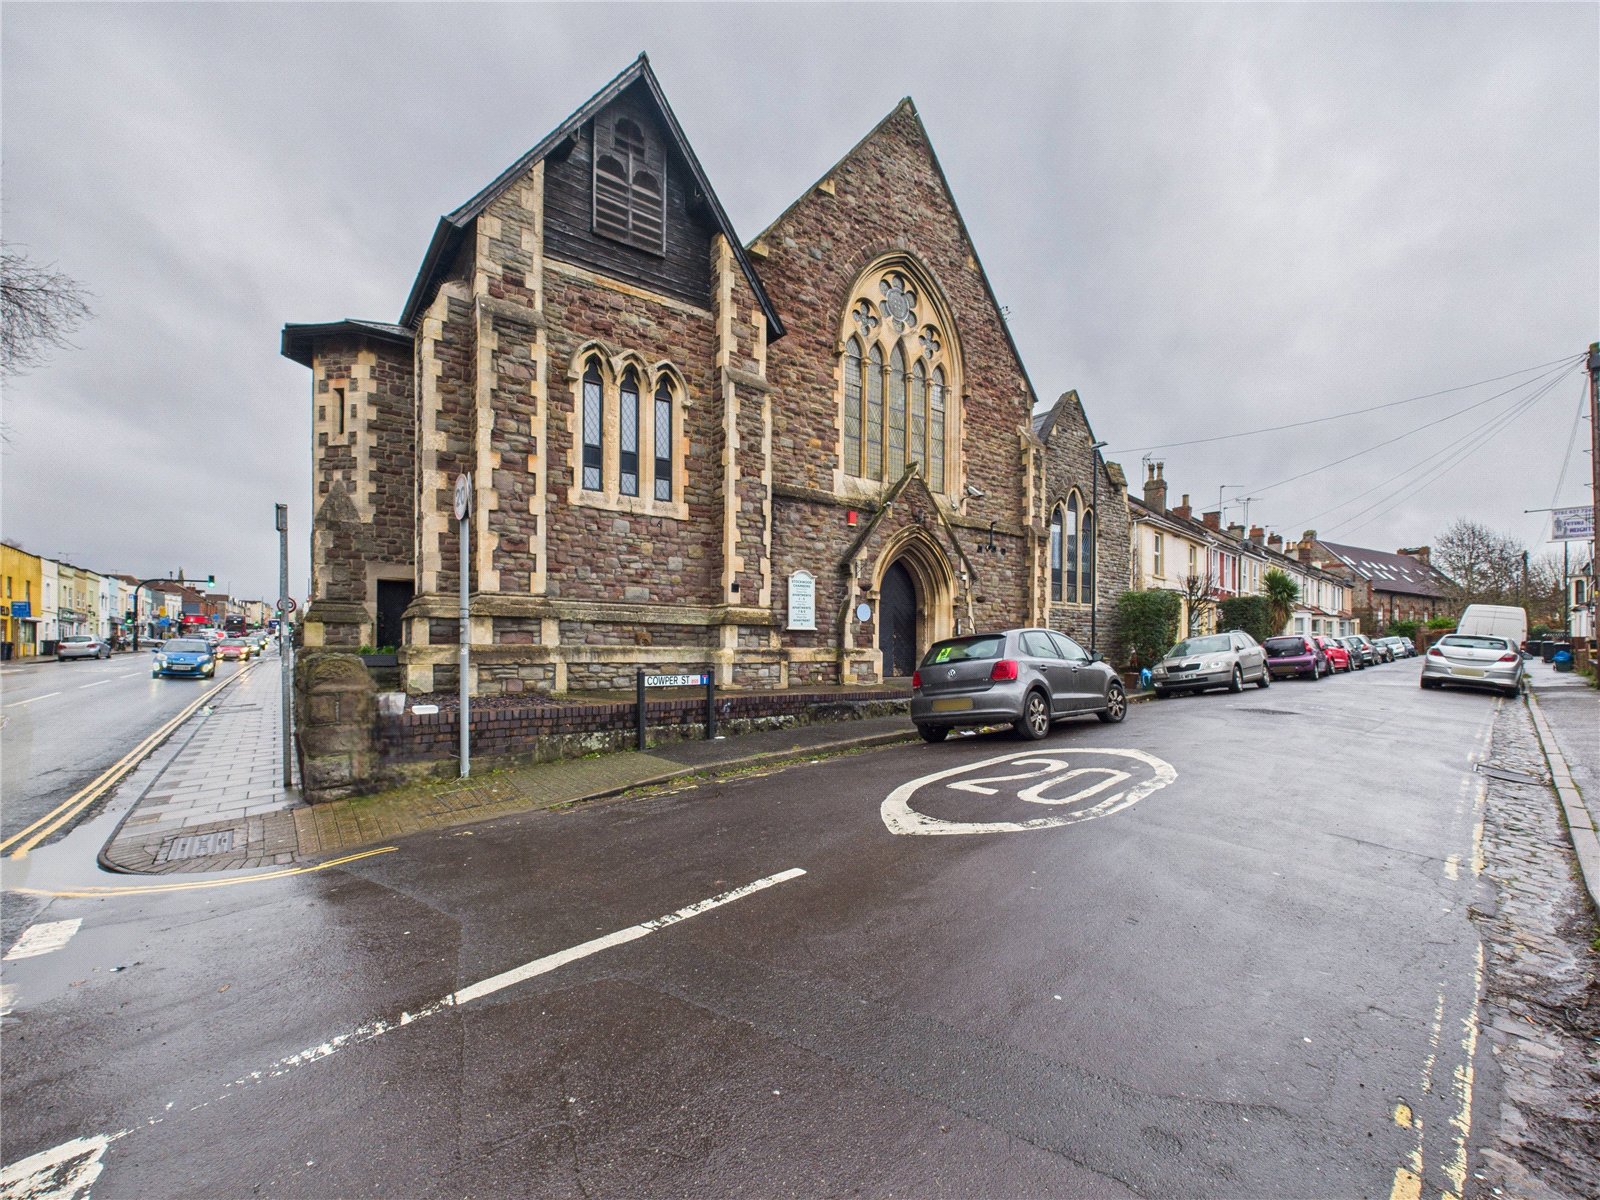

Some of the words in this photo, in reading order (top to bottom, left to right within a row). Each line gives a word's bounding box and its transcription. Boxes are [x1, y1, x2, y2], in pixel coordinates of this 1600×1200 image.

[456, 486, 465, 507] 20
[647, 676, 678, 685] COWPER
[681, 676, 690, 684] ST
[946, 758, 1132, 804] 20
